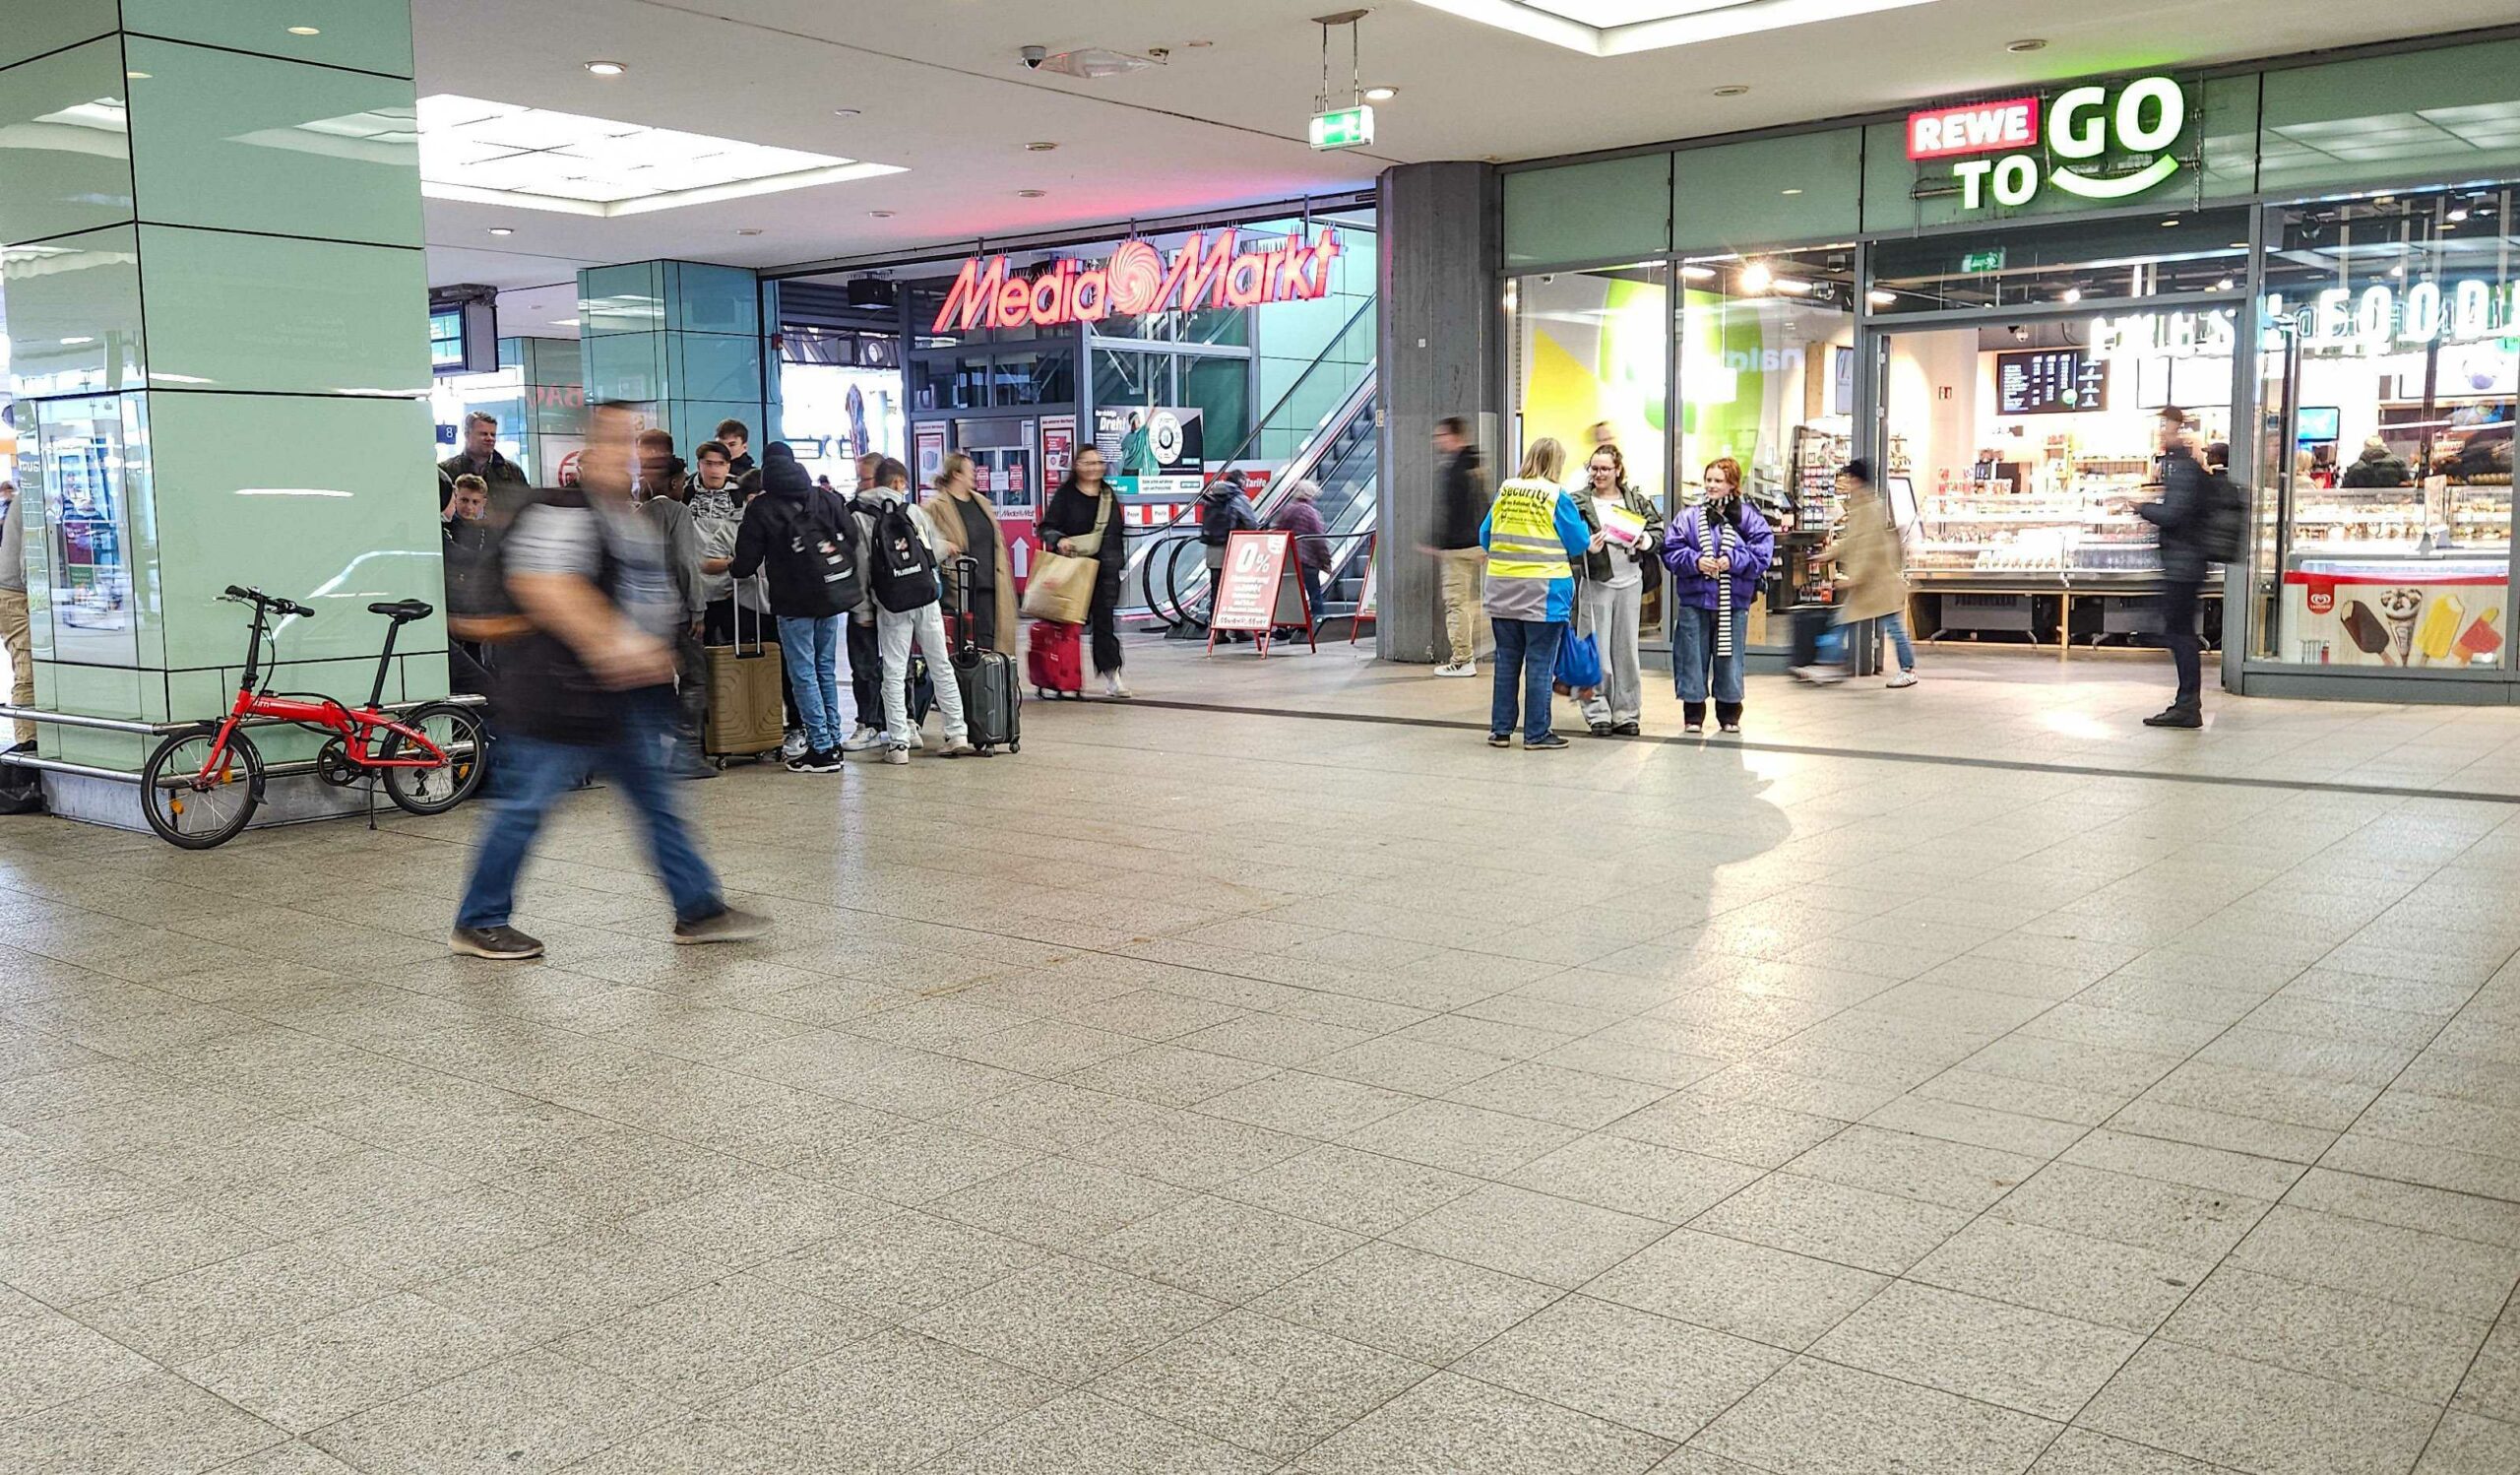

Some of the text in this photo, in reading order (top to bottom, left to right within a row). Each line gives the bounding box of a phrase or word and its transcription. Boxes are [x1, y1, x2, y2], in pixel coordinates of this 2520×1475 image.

[1915, 104, 2029, 152] REWE
[2048, 76, 2184, 159] GO
[1953, 155, 2039, 209] TO
[931, 227, 1340, 333] Media Markt
[446, 426, 454, 439] 8
[1500, 485, 1550, 504] Security
[1234, 542, 1271, 574] 0%
